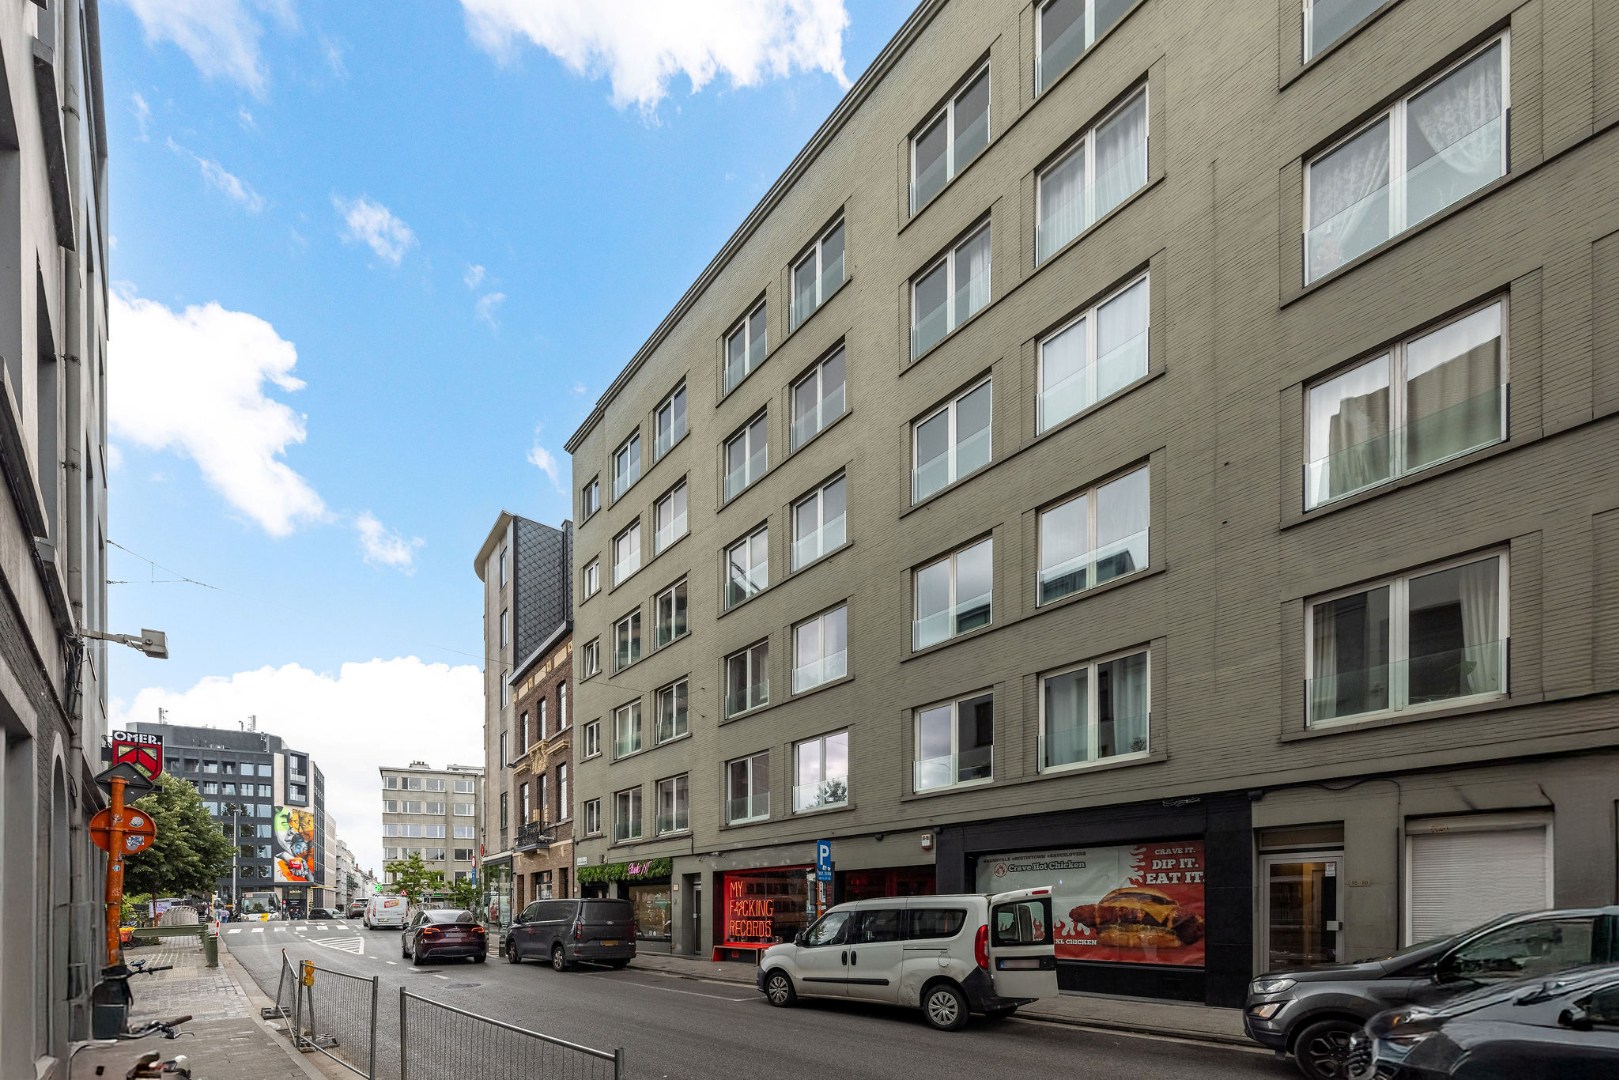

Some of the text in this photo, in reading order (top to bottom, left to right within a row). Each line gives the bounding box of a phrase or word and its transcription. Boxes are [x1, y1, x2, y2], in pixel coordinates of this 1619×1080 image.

[819, 845, 830, 865] P
[1154, 847, 1183, 855] CRAVE
[1008, 860, 1086, 872] Crave Hot Chicken
[1152, 858, 1199, 870] DIP IT.
[1145, 872, 1181, 885] EAT
[730, 881, 743, 897] MY
[730, 920, 773, 937] RECORDS
